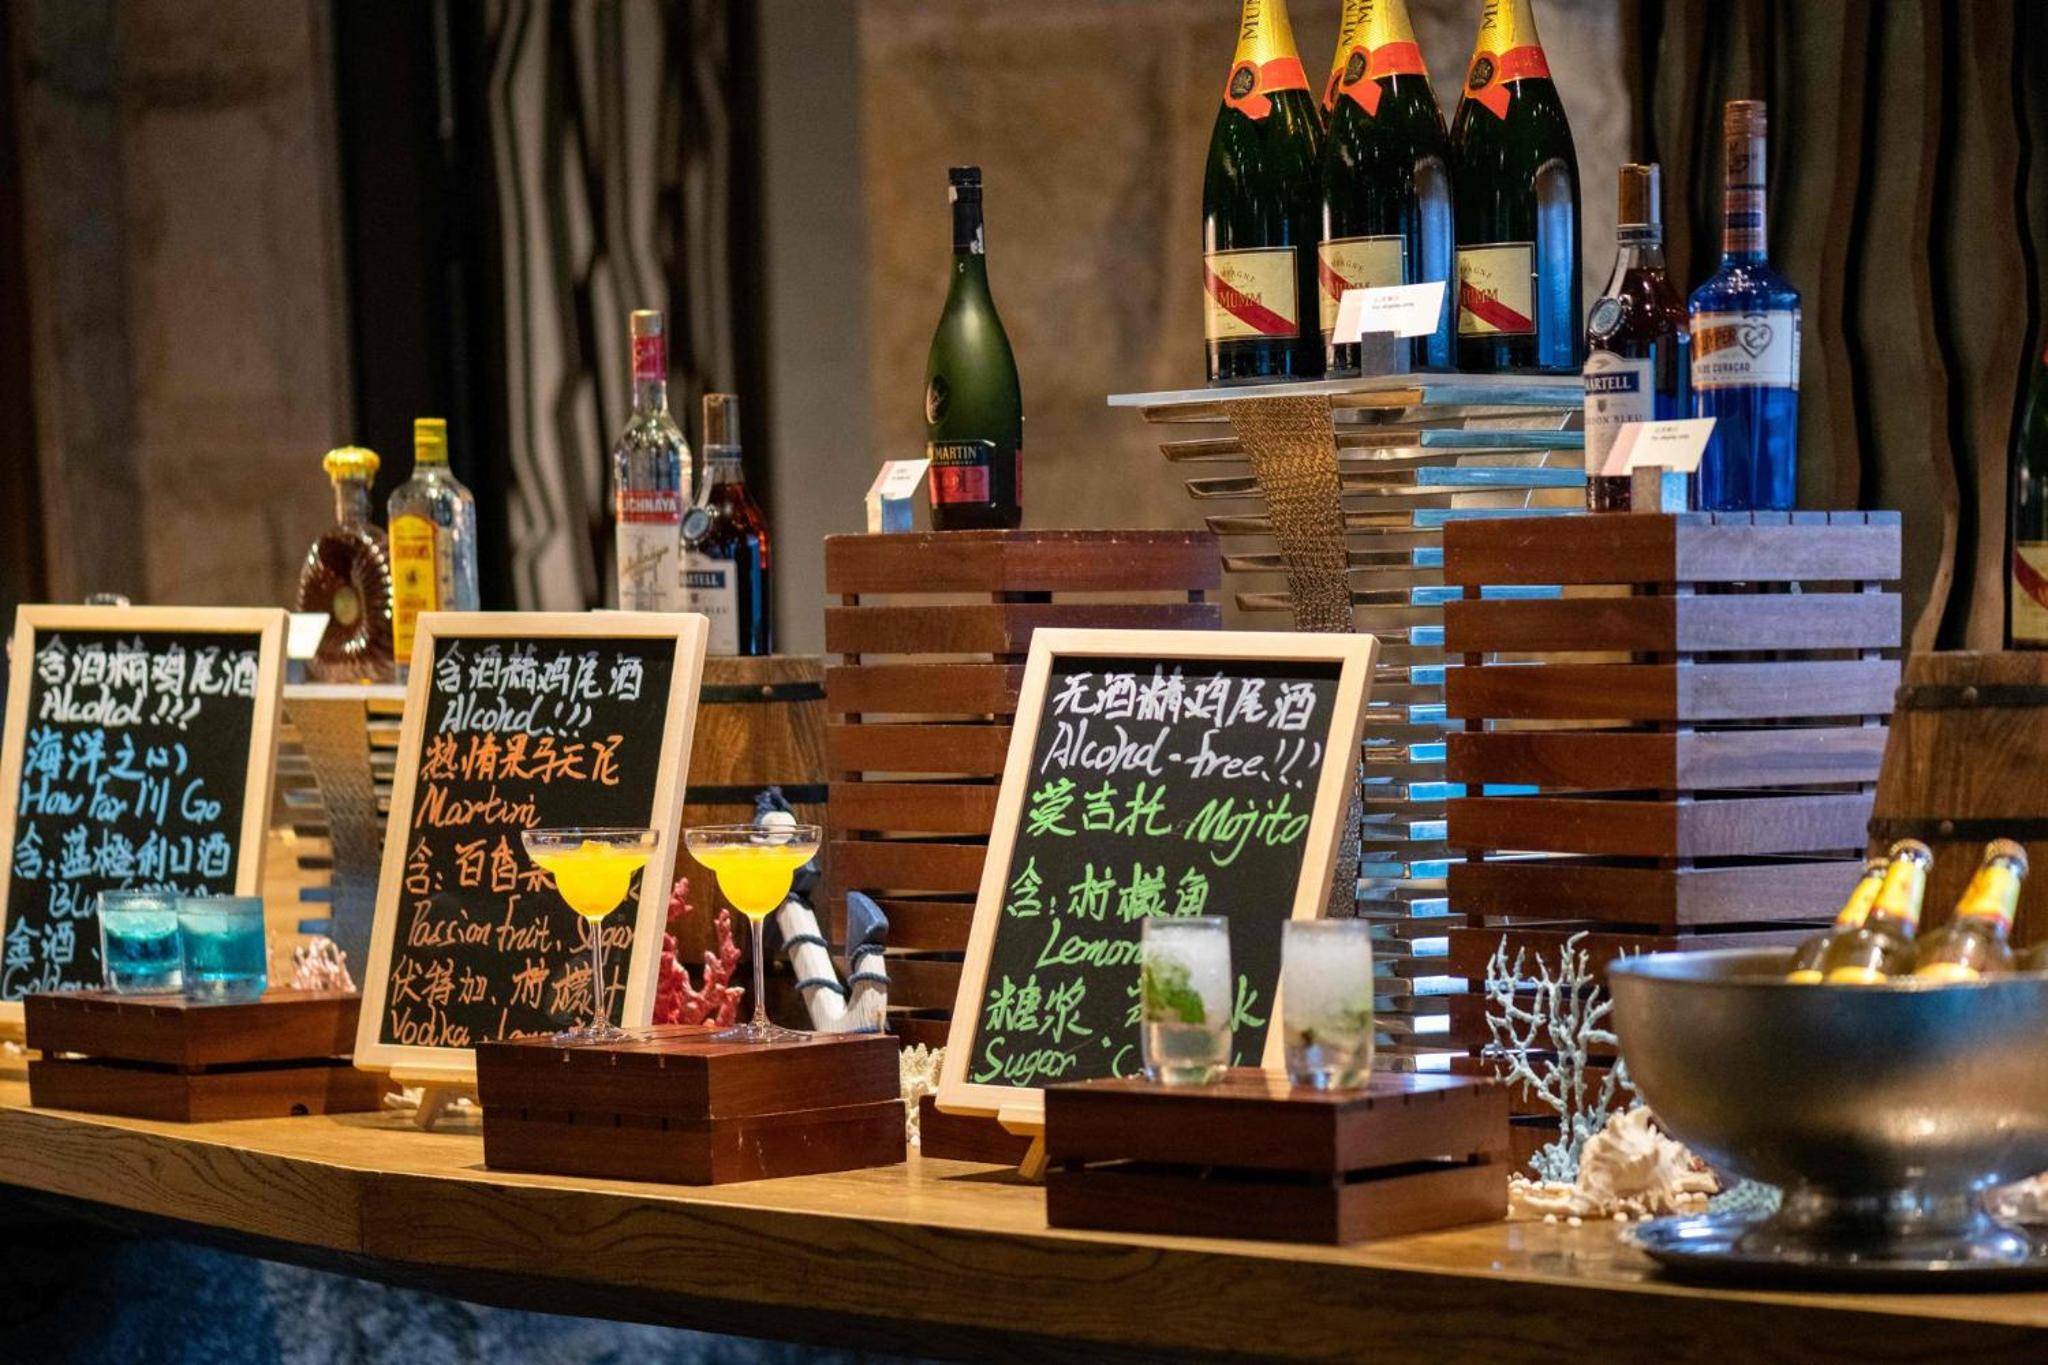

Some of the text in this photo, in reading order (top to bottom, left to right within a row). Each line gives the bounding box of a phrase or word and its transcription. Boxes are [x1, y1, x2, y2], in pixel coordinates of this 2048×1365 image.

[934, 446, 977, 459] MARTIN
[1052, 664, 1318, 731] 无酒精鸡尾酒
[25, 724, 188, 785] 海洋之心
[19, 774, 85, 816] How
[181, 778, 222, 822] Go
[415, 782, 542, 829] Martini
[1026, 777, 1310, 868] 莫吉托 Mojito
[50, 882, 100, 918] Blu
[408, 899, 490, 948] Passion
[974, 1037, 1077, 1088] Sugar
